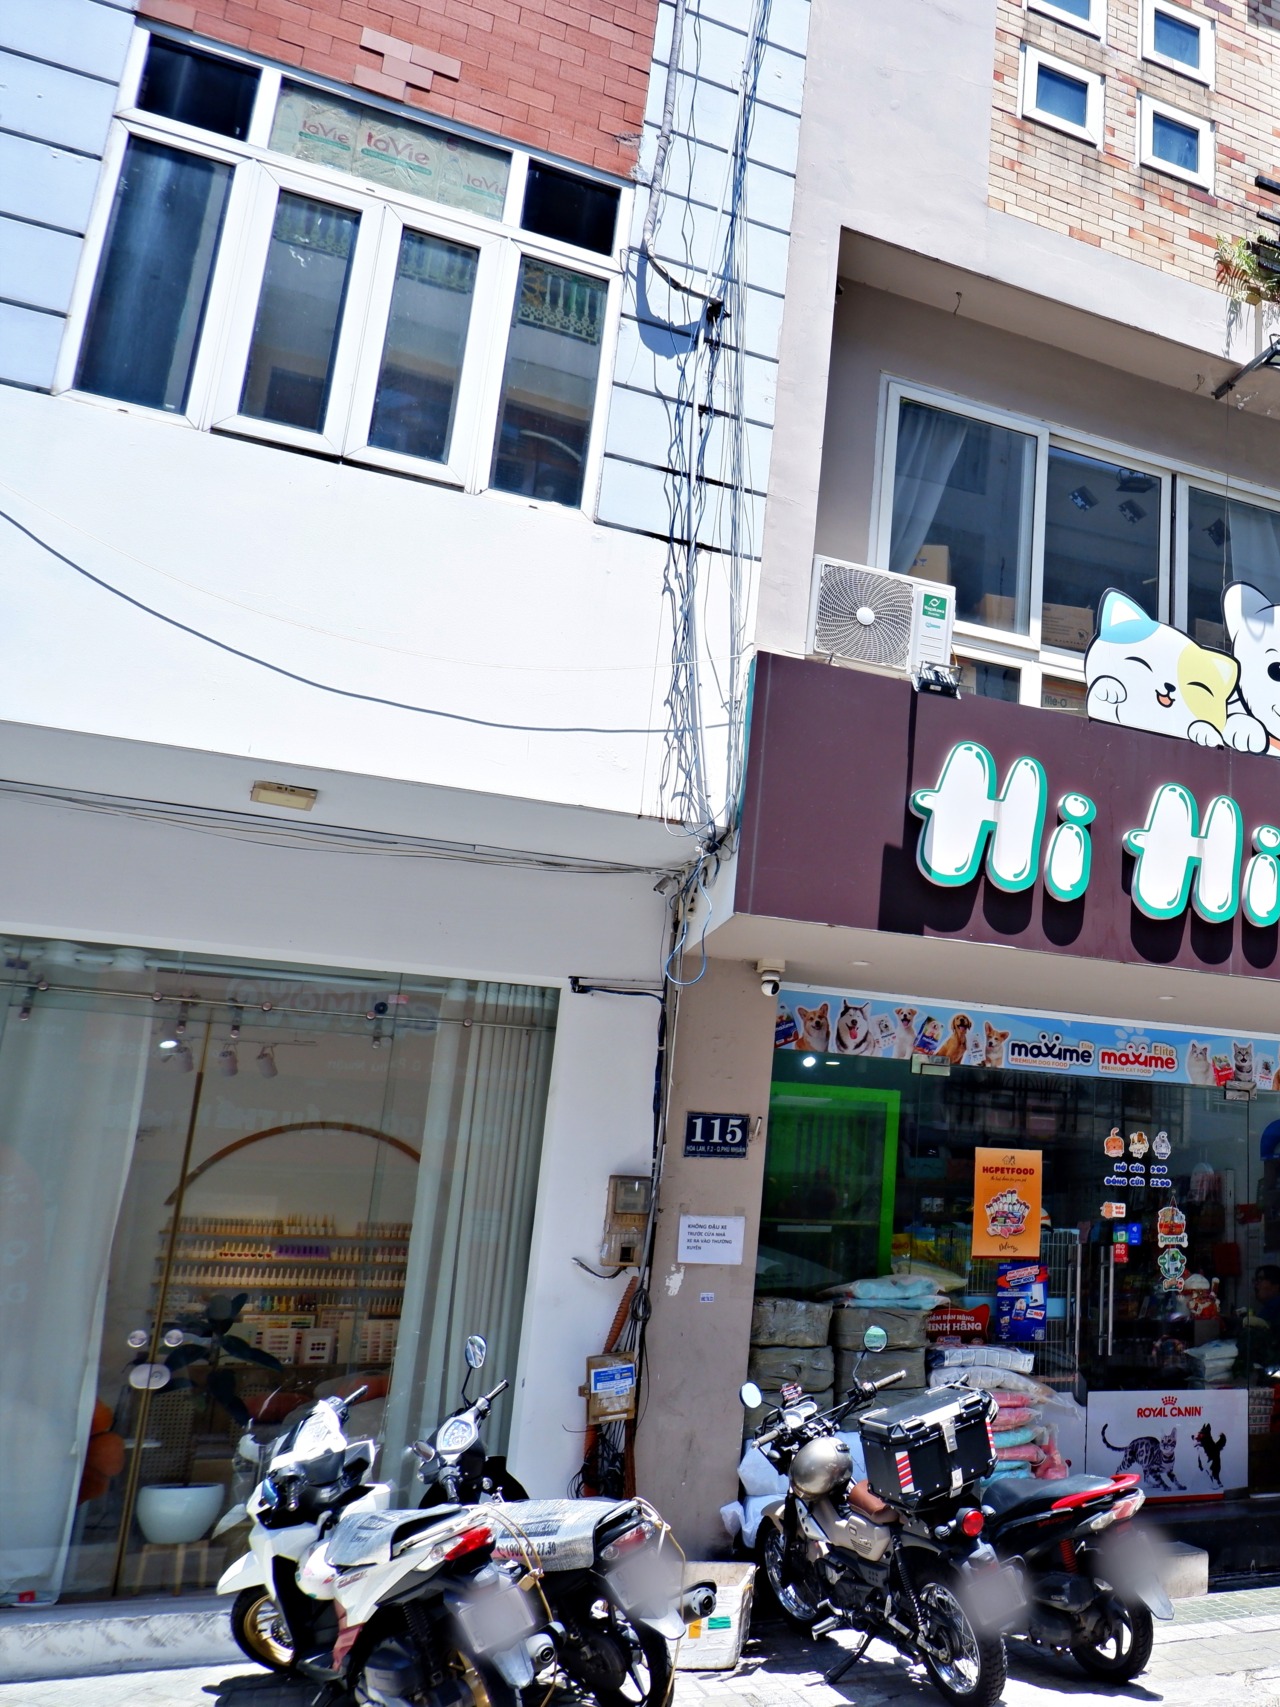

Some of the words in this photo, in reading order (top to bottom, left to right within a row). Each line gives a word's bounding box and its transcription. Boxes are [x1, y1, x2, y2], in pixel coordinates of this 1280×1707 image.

[909, 741, 1097, 902] Hi
[1010, 1033, 1093, 1063] maxime
[1010, 1057, 1037, 1065] PREMIUM
[1037, 1059, 1051, 1067] DOG
[1051, 1060, 1068, 1068] FOOD
[1101, 1045, 1176, 1070] maxime
[1153, 1045, 1174, 1057] Elite
[691, 1117, 742, 1144] 115
[982, 1166, 1035, 1176] HGPETFOOD
[1160, 1235, 1185, 1243] Drontal
[1137, 1407, 1168, 1418] ROYAL
[1169, 1406, 1202, 1417] CANIN
